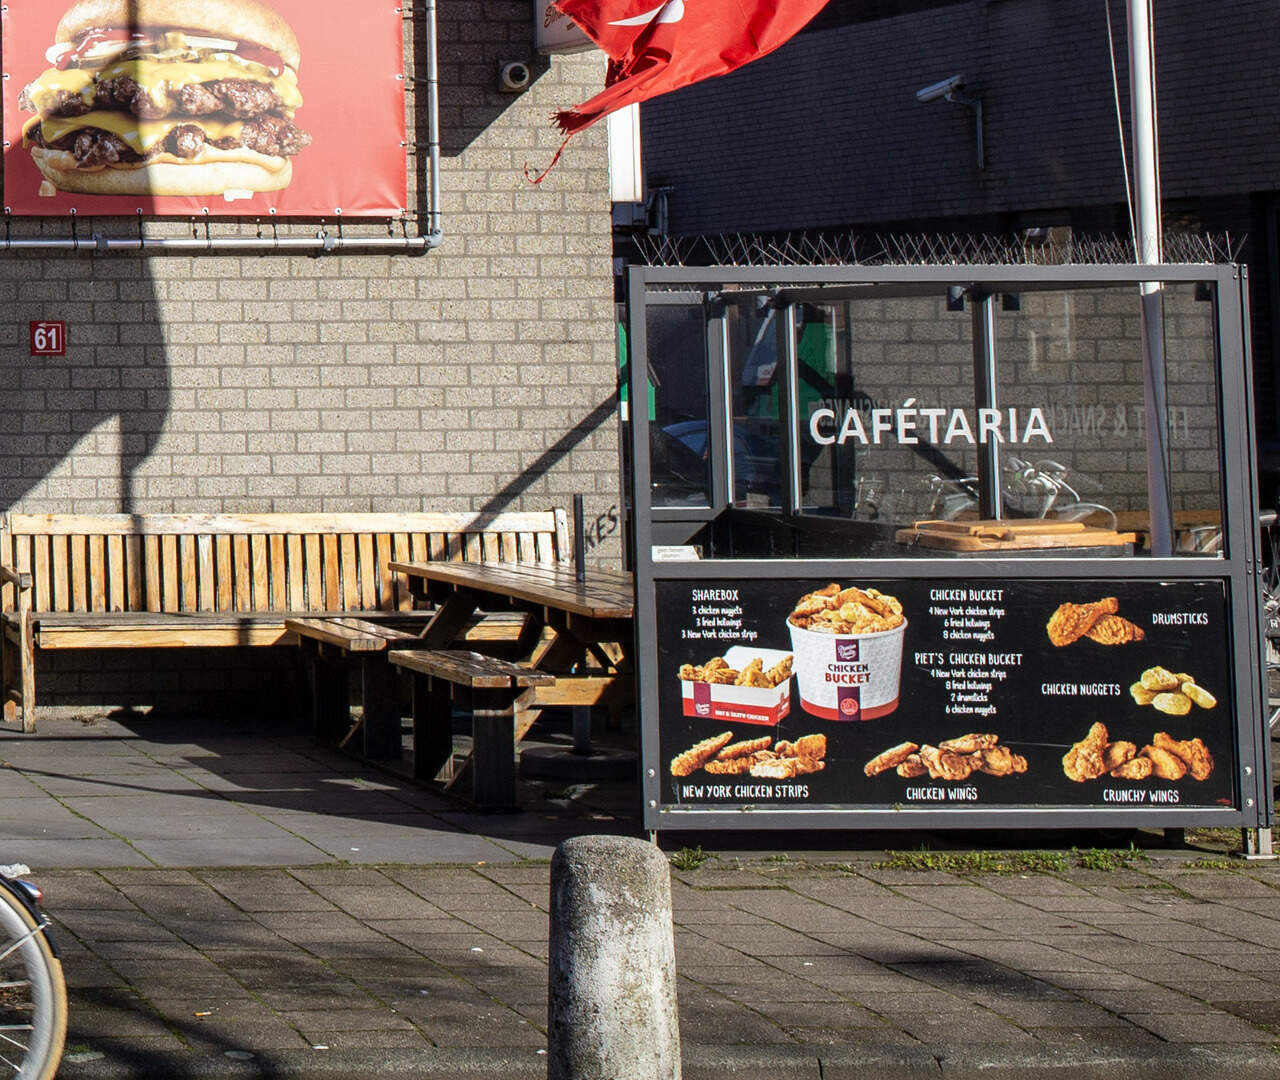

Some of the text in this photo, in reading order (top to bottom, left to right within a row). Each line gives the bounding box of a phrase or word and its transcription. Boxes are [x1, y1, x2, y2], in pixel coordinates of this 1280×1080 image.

[34, 328, 56, 350] 61
[809, 398, 1053, 445] CAFÉTARIA
[692, 589, 739, 601] SHAREBOX
[930, 589, 1003, 601] CHICKEN BUCKET
[698, 605, 719, 615] chicken
[721, 605, 742, 617] nuggets
[934, 607, 948, 616] New
[949, 606, 964, 616] York
[965, 606, 987, 616] chicken
[988, 606, 1005, 619] strips
[701, 618, 715, 627] fried
[716, 618, 742, 629] hotwings
[944, 618, 991, 630] 6 fried hotwings
[1152, 613, 1209, 625] DRUMSTICKS
[687, 630, 701, 639] New
[702, 630, 717, 639] York
[718, 629, 740, 639] chicken
[741, 629, 758, 641] strips
[950, 630, 971, 639] chicken
[973, 630, 994, 642] nuggets
[914, 652, 1022, 665] PIET'S CHICKEN BUCKET
[828, 663, 868, 672] CHICKEN
[825, 673, 870, 684] BUCKET
[936, 669, 950, 678] New
[951, 669, 966, 678] York
[967, 668, 989, 678] chicken
[990, 669, 1007, 681] strips
[952, 680, 966, 690] fried
[967, 680, 992, 693] hotwings
[1041, 683, 1121, 696] CHICKEN NUGGETS
[957, 692, 988, 701] drumsticks
[945, 704, 997, 717] 6 chicken nuggets
[682, 785, 809, 798] NEW YORK CHICKEN STRIPS
[906, 787, 978, 800] CHICKEN WINGS
[1103, 789, 1180, 803] CRUNCHY WINGS
